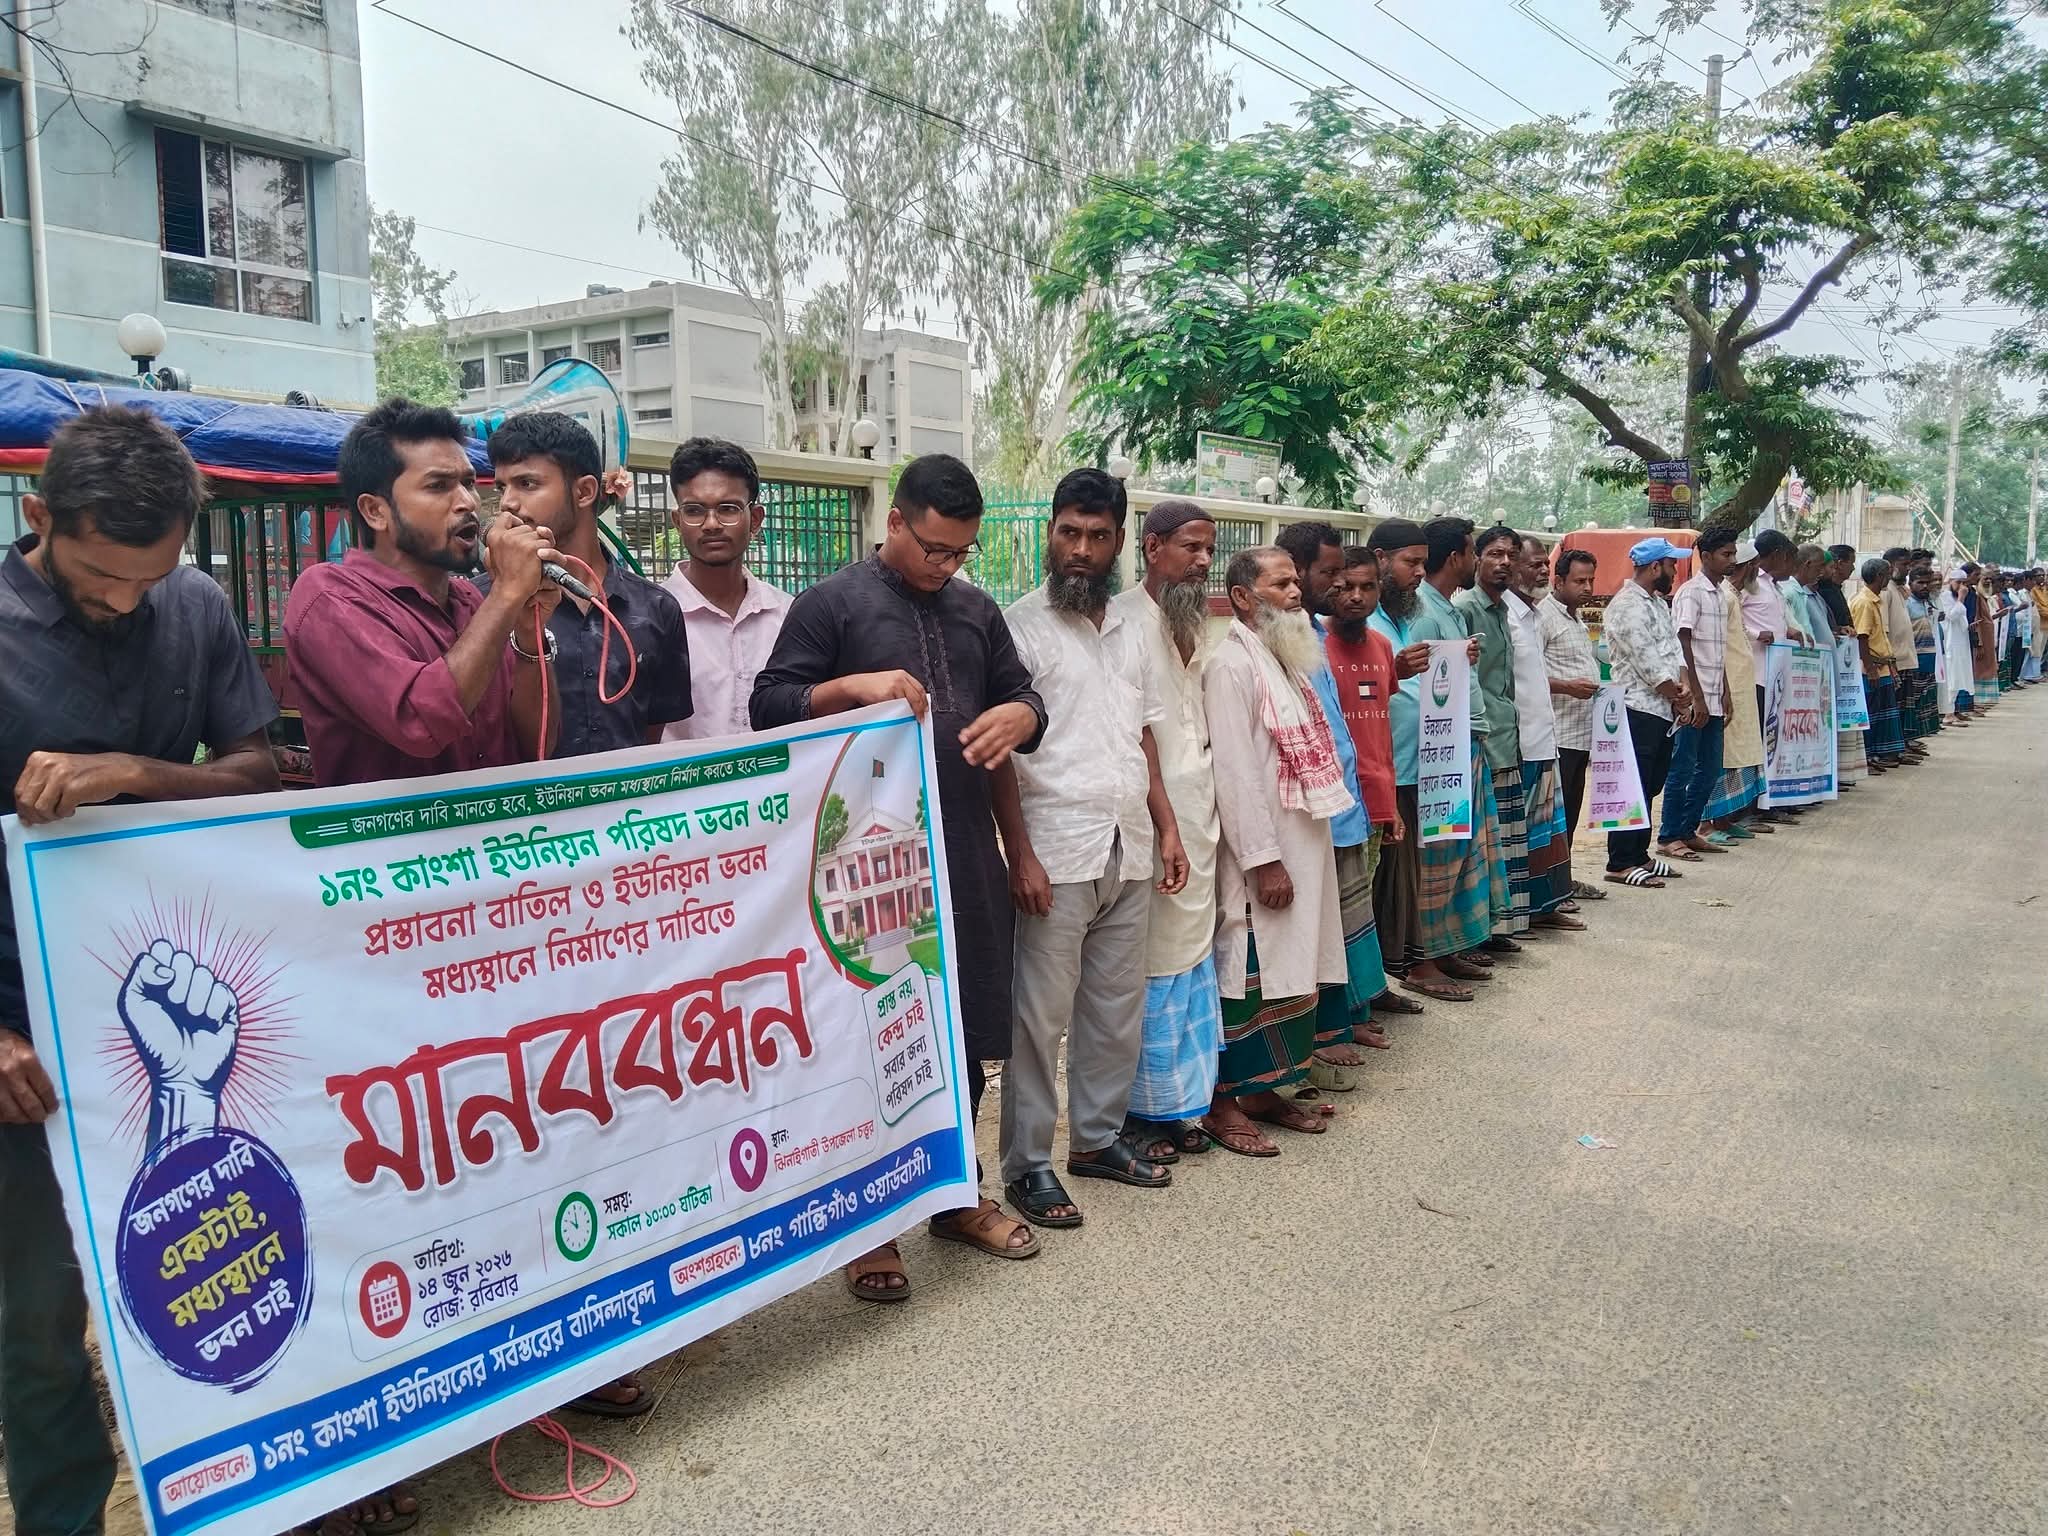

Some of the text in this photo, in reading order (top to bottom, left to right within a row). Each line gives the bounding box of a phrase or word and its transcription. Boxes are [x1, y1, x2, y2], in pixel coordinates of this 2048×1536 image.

[1337, 663, 1386, 673] TOMMY
[351, 757, 758, 836] জনগণের দাবি মানতে হবে, ইউনিয়ন ভবন মধ্যস্থানে নির্মাণ করতে হবে
[1441, 773, 1463, 789] ভবন
[319, 793, 790, 907] ১নং কাংশা ইউনিয়ন পরিষদ ভবন এর
[364, 845, 767, 956] প্রস্তাবনা বাতিল ও ইউনিয়ন ভবন
[423, 898, 736, 999] মধ্যস্থানে নির্মাণের দাবিতে
[878, 998, 925, 1051] কেন্দ্র চাই
[883, 1035, 928, 1080] সবার জন্য
[325, 947, 813, 1192] মানববন্ধন
[886, 1059, 934, 1110] পরিষদ চাই
[774, 1138, 820, 1172] ঝিনাইগাতী
[821, 1127, 856, 1153] উপজেলা
[129, 1137, 257, 1236] জনগণের দাবি
[606, 1184, 713, 1240] সকাল ১০:০০ ঘটিকা
[160, 1190, 268, 1280] একটাই,
[748, 1225, 784, 1260] ৮নং
[167, 1231, 286, 1327] মধ্যস্থানে
[418, 1250, 513, 1301] ১৪ জুন ২০২৬
[468, 1274, 519, 1312] রবিবার
[195, 1277, 295, 1362] ভবন চাই
[261, 1279, 657, 1471] ১নং কাংশা ইউনিয়নের সর্বস্তরের বাসিন্দাবৃন্দ
